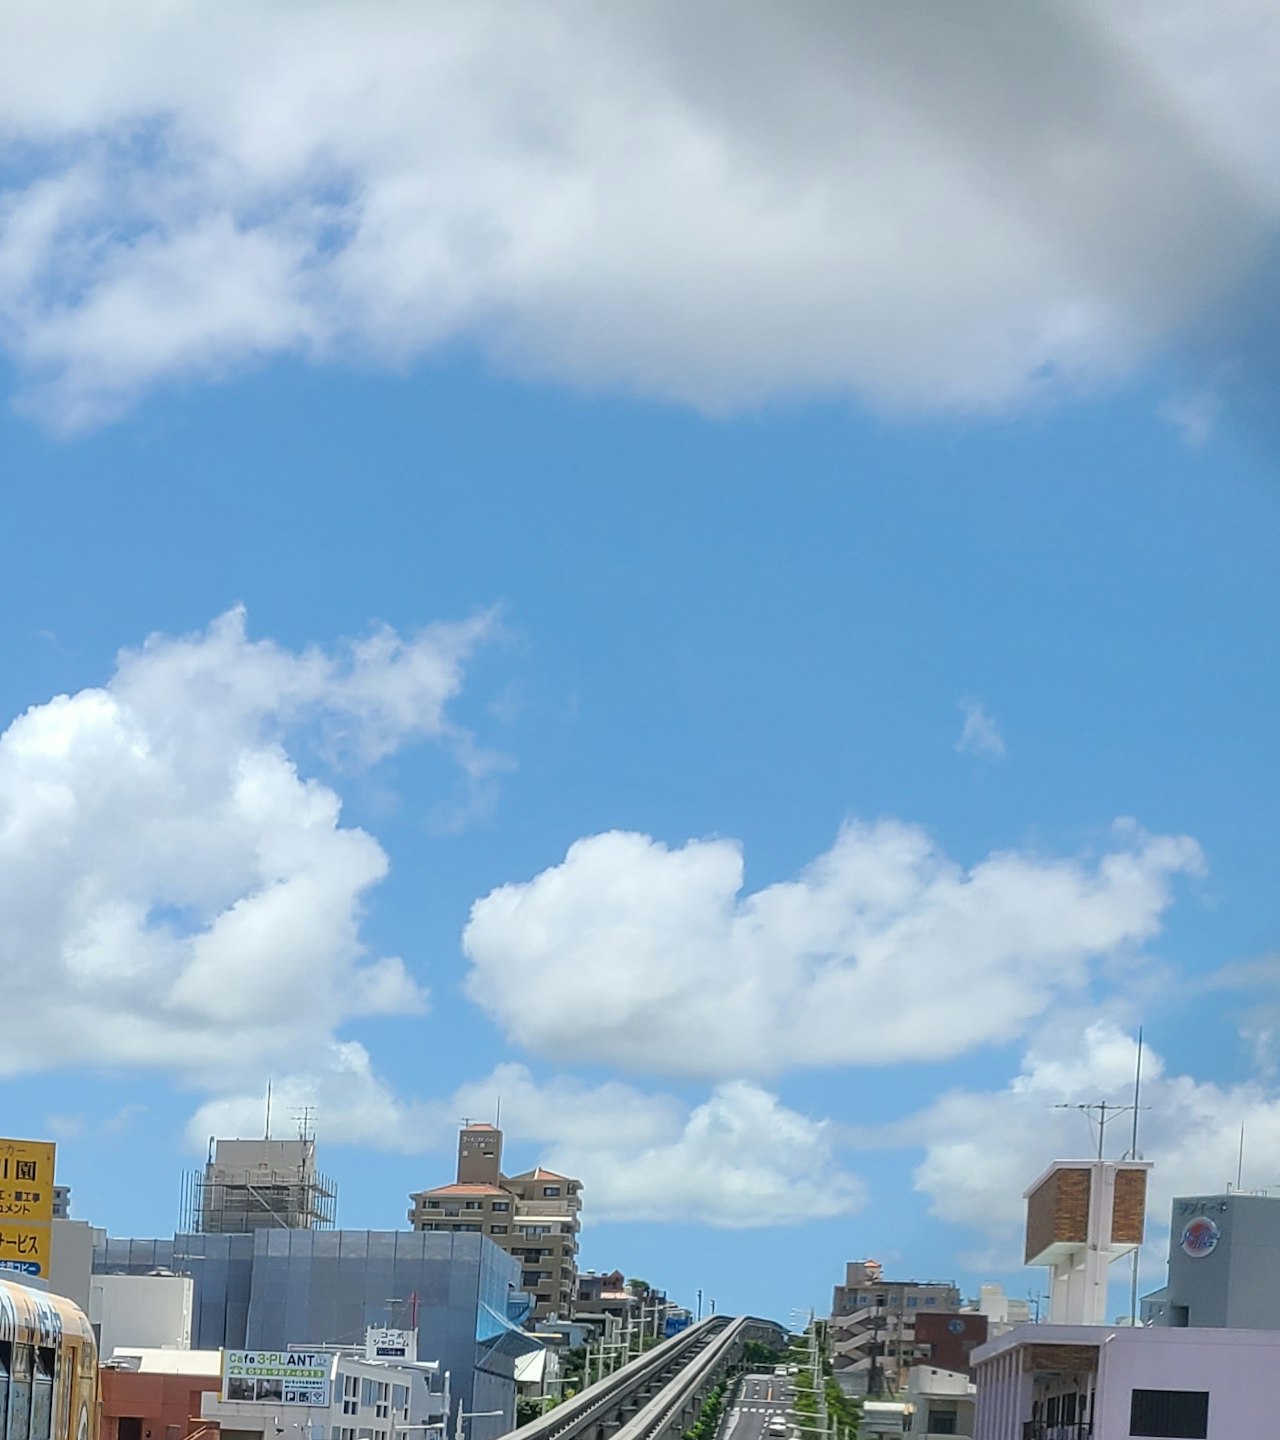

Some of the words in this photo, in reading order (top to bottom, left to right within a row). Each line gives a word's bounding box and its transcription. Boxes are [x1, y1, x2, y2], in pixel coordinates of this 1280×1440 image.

[373, 1339, 409, 1347] シャローム
[229, 1353, 255, 1364] Cafe
